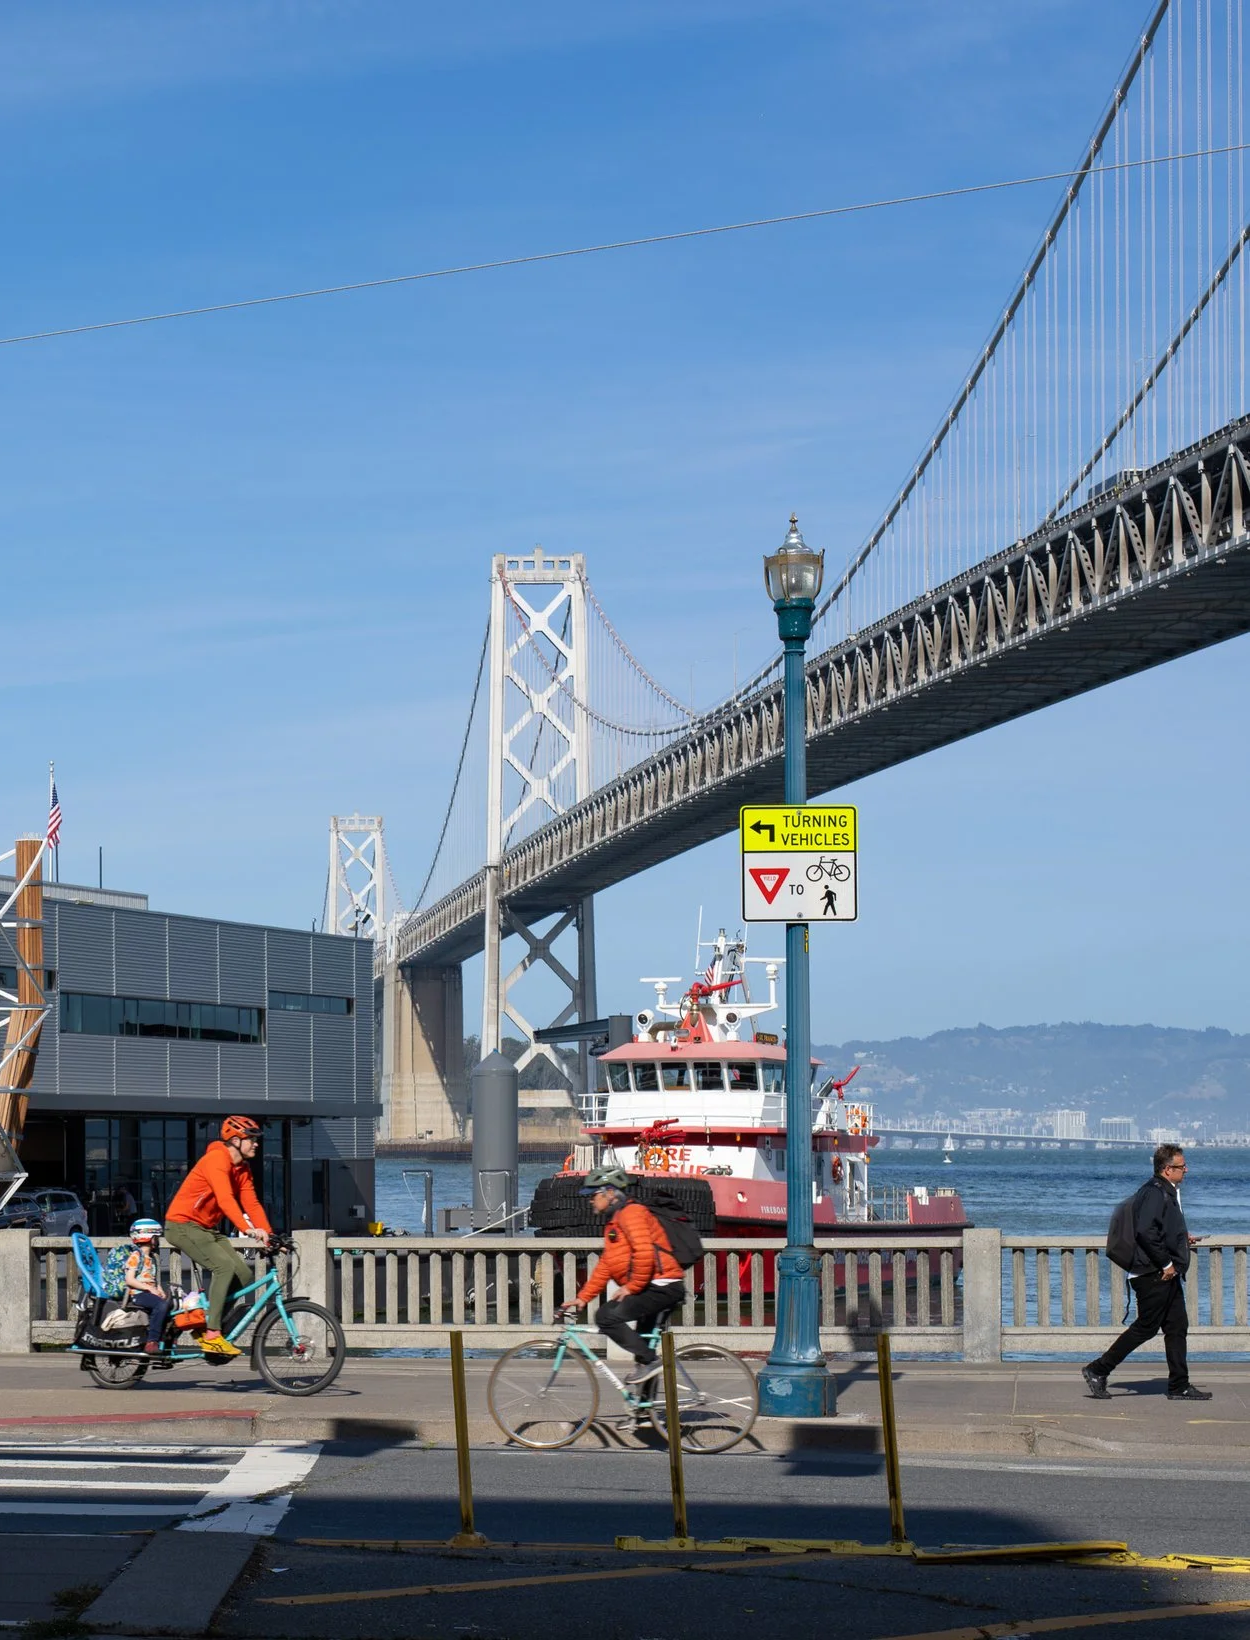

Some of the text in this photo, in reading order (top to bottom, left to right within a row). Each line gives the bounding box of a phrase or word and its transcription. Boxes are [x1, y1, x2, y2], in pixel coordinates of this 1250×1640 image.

[783, 815, 847, 828] TURNING
[781, 833, 850, 846] VEHICLES
[789, 884, 804, 895] TO
[760, 1206, 787, 1214] FIREBOAT
